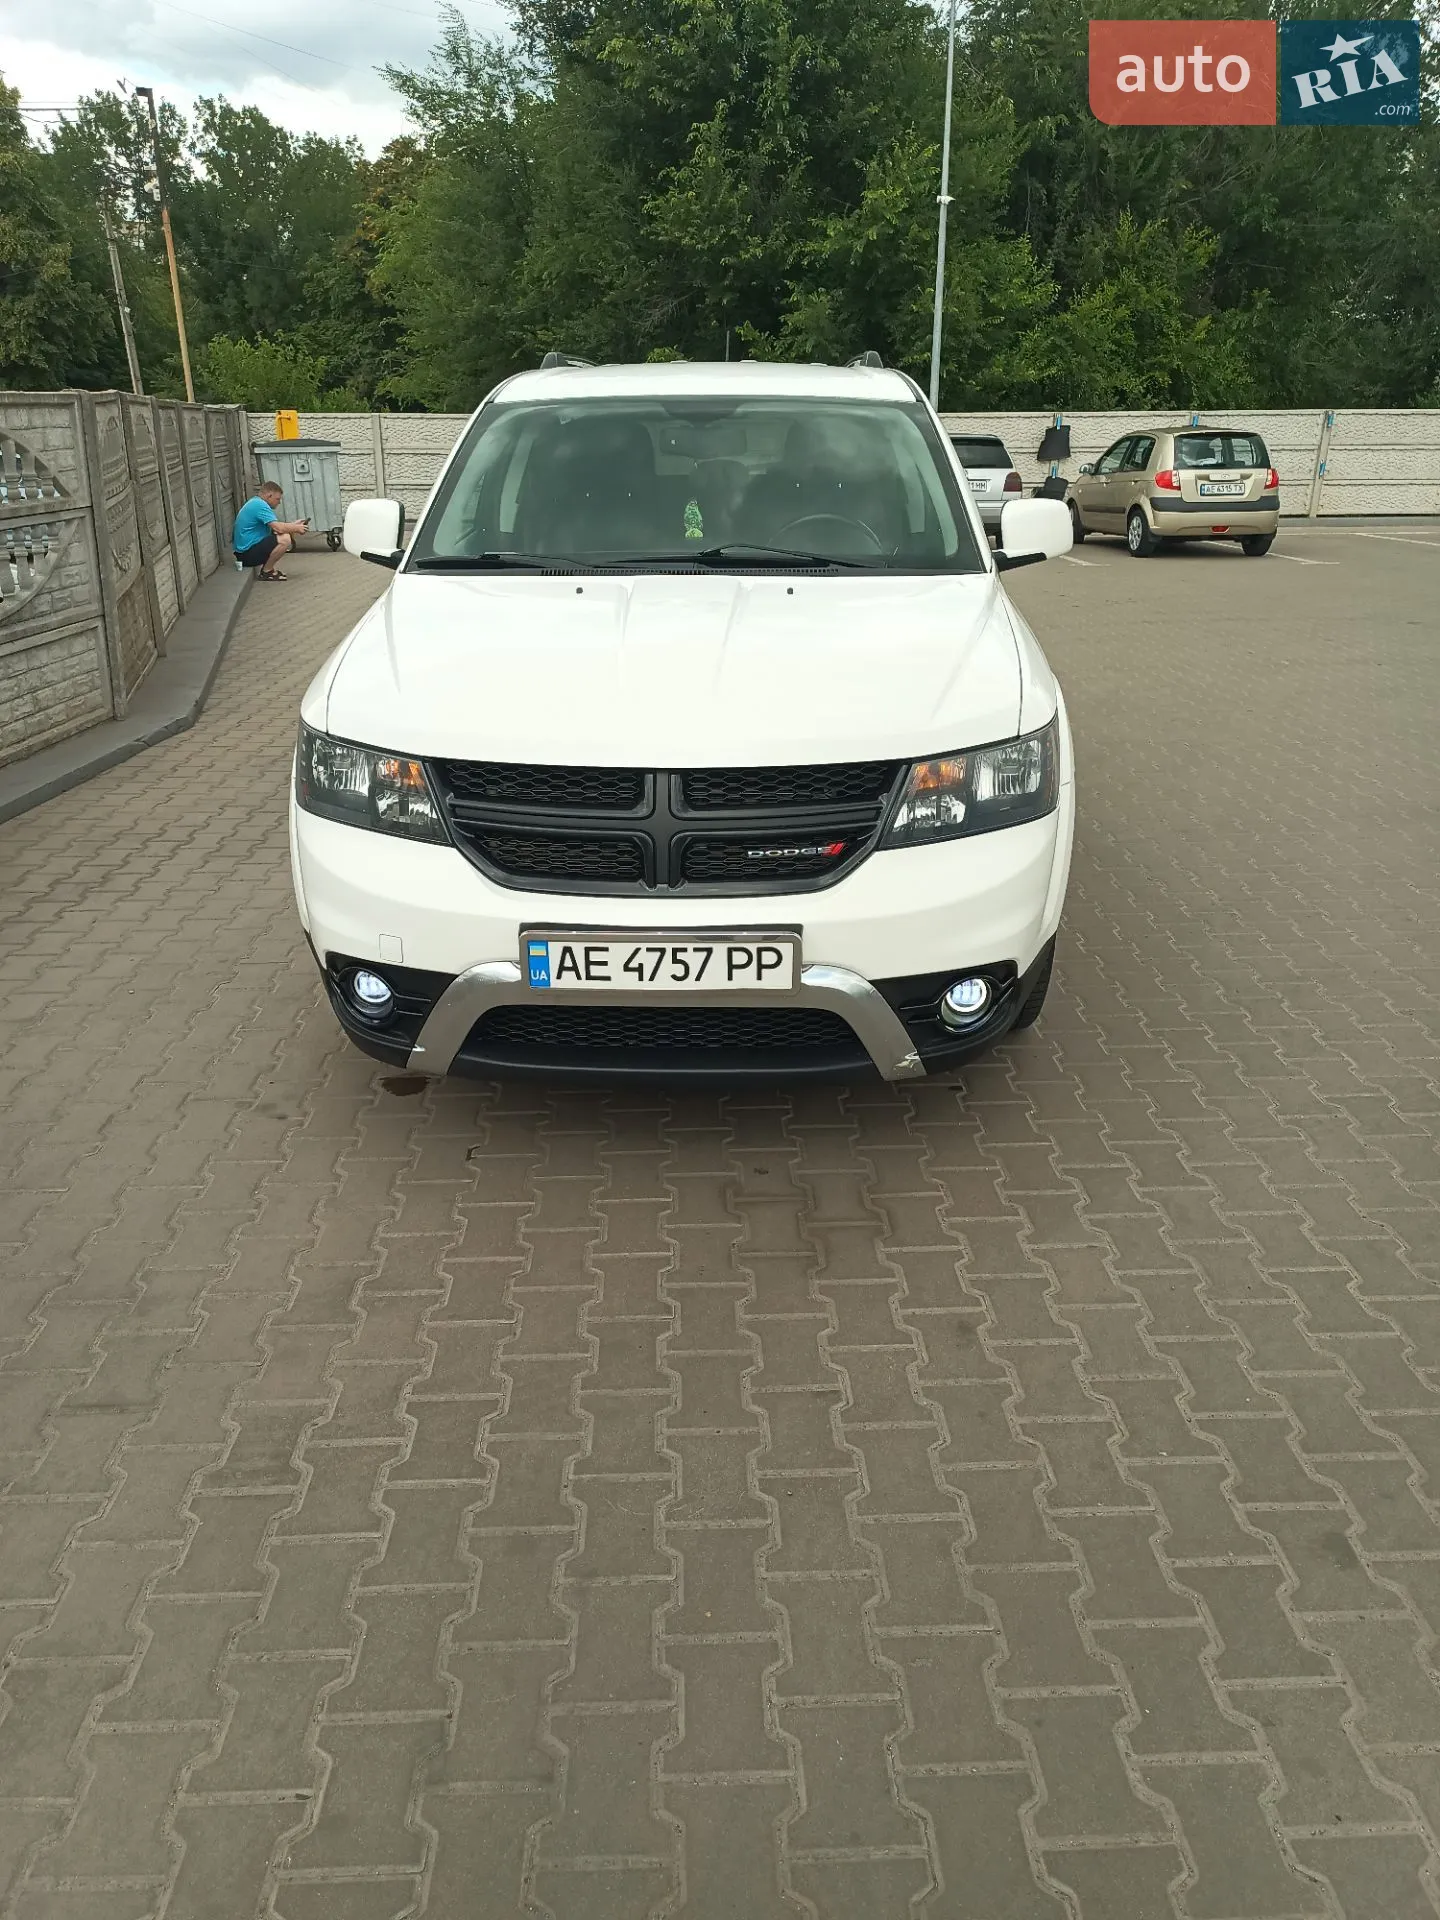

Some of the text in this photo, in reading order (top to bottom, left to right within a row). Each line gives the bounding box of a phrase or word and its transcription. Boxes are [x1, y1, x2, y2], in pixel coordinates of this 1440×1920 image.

[748, 846, 831, 858] DODGE
[556, 946, 783, 982] AE 4757 PP
[530, 969, 548, 981] UA
